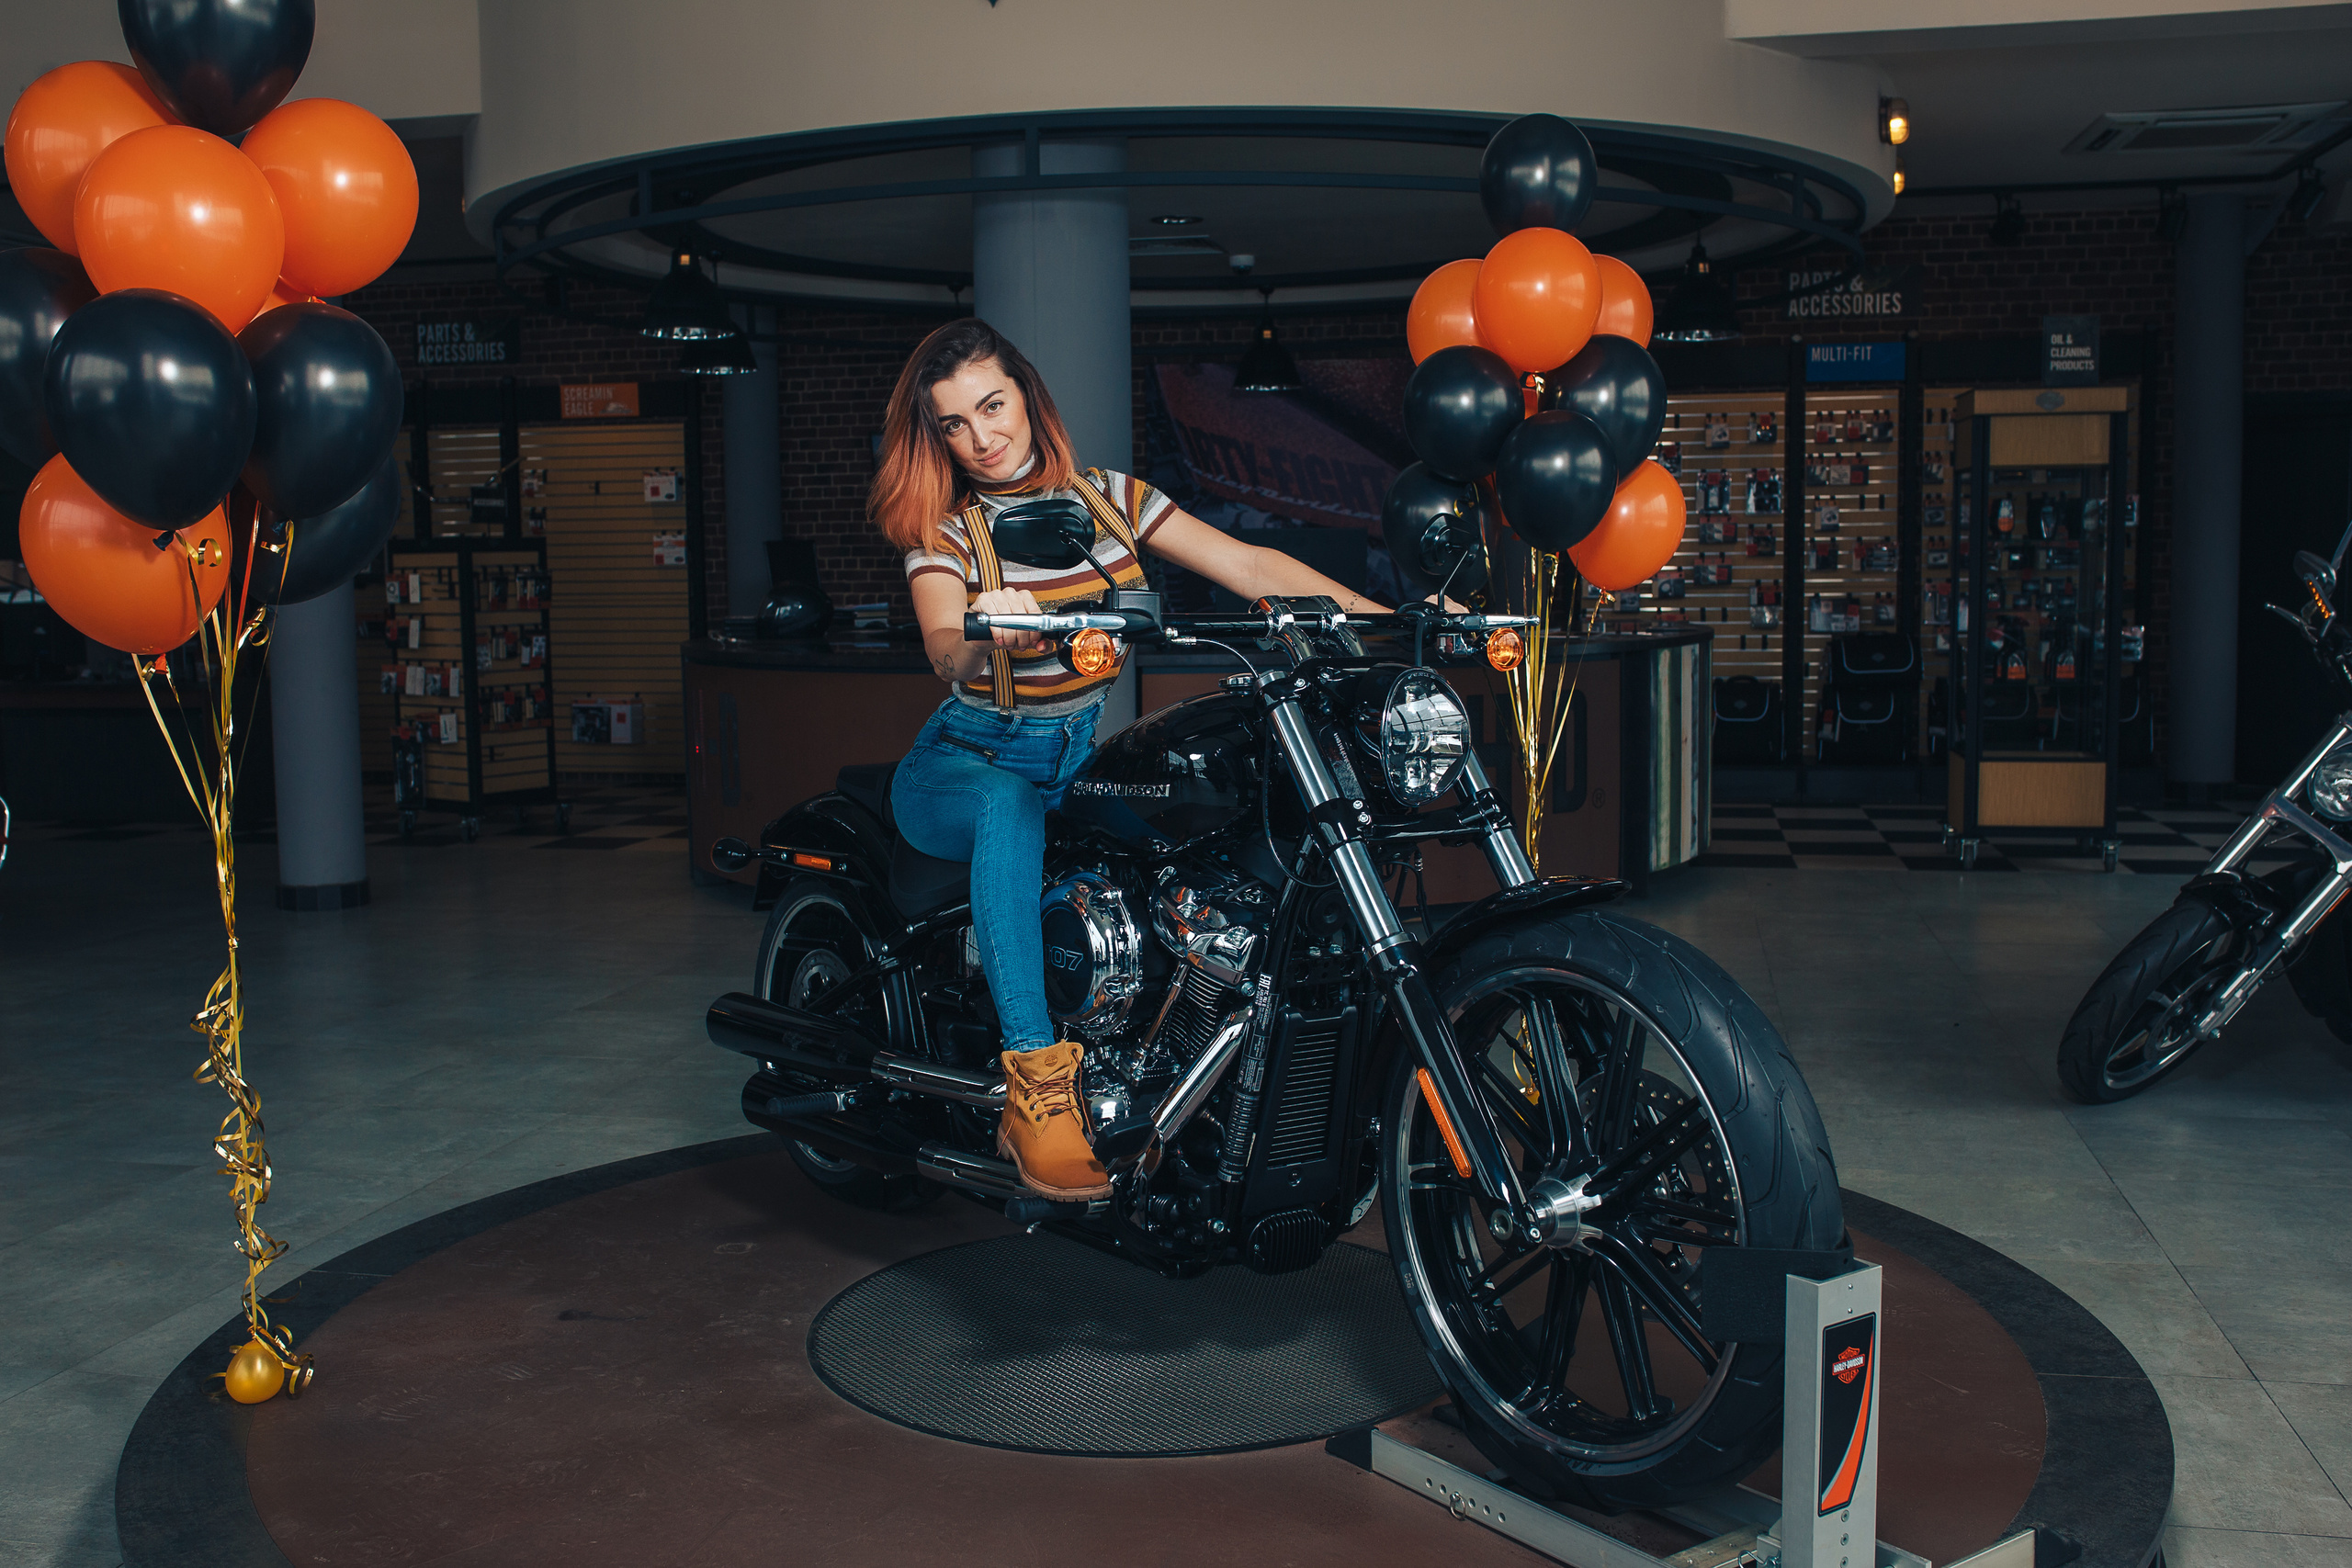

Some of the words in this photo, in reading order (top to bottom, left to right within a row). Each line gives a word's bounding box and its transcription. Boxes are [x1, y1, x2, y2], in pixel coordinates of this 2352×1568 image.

[1788, 293, 1902, 317] ACCESSORIES
[416, 323, 460, 344] PARTS
[463, 322, 476, 343] &
[2051, 333, 2064, 344] OIL
[2066, 333, 2074, 344] &
[417, 342, 505, 364] ACCESSORIES
[1811, 345, 1872, 362] MULTI-FIT
[2051, 346, 2092, 357] CLEANING
[2050, 359, 2095, 371] PRODUCTS
[564, 401, 594, 416] EAGLE
[1045, 943, 1084, 971] 107
[1833, 1356, 1863, 1373] HARLEY-DAVIDSON
